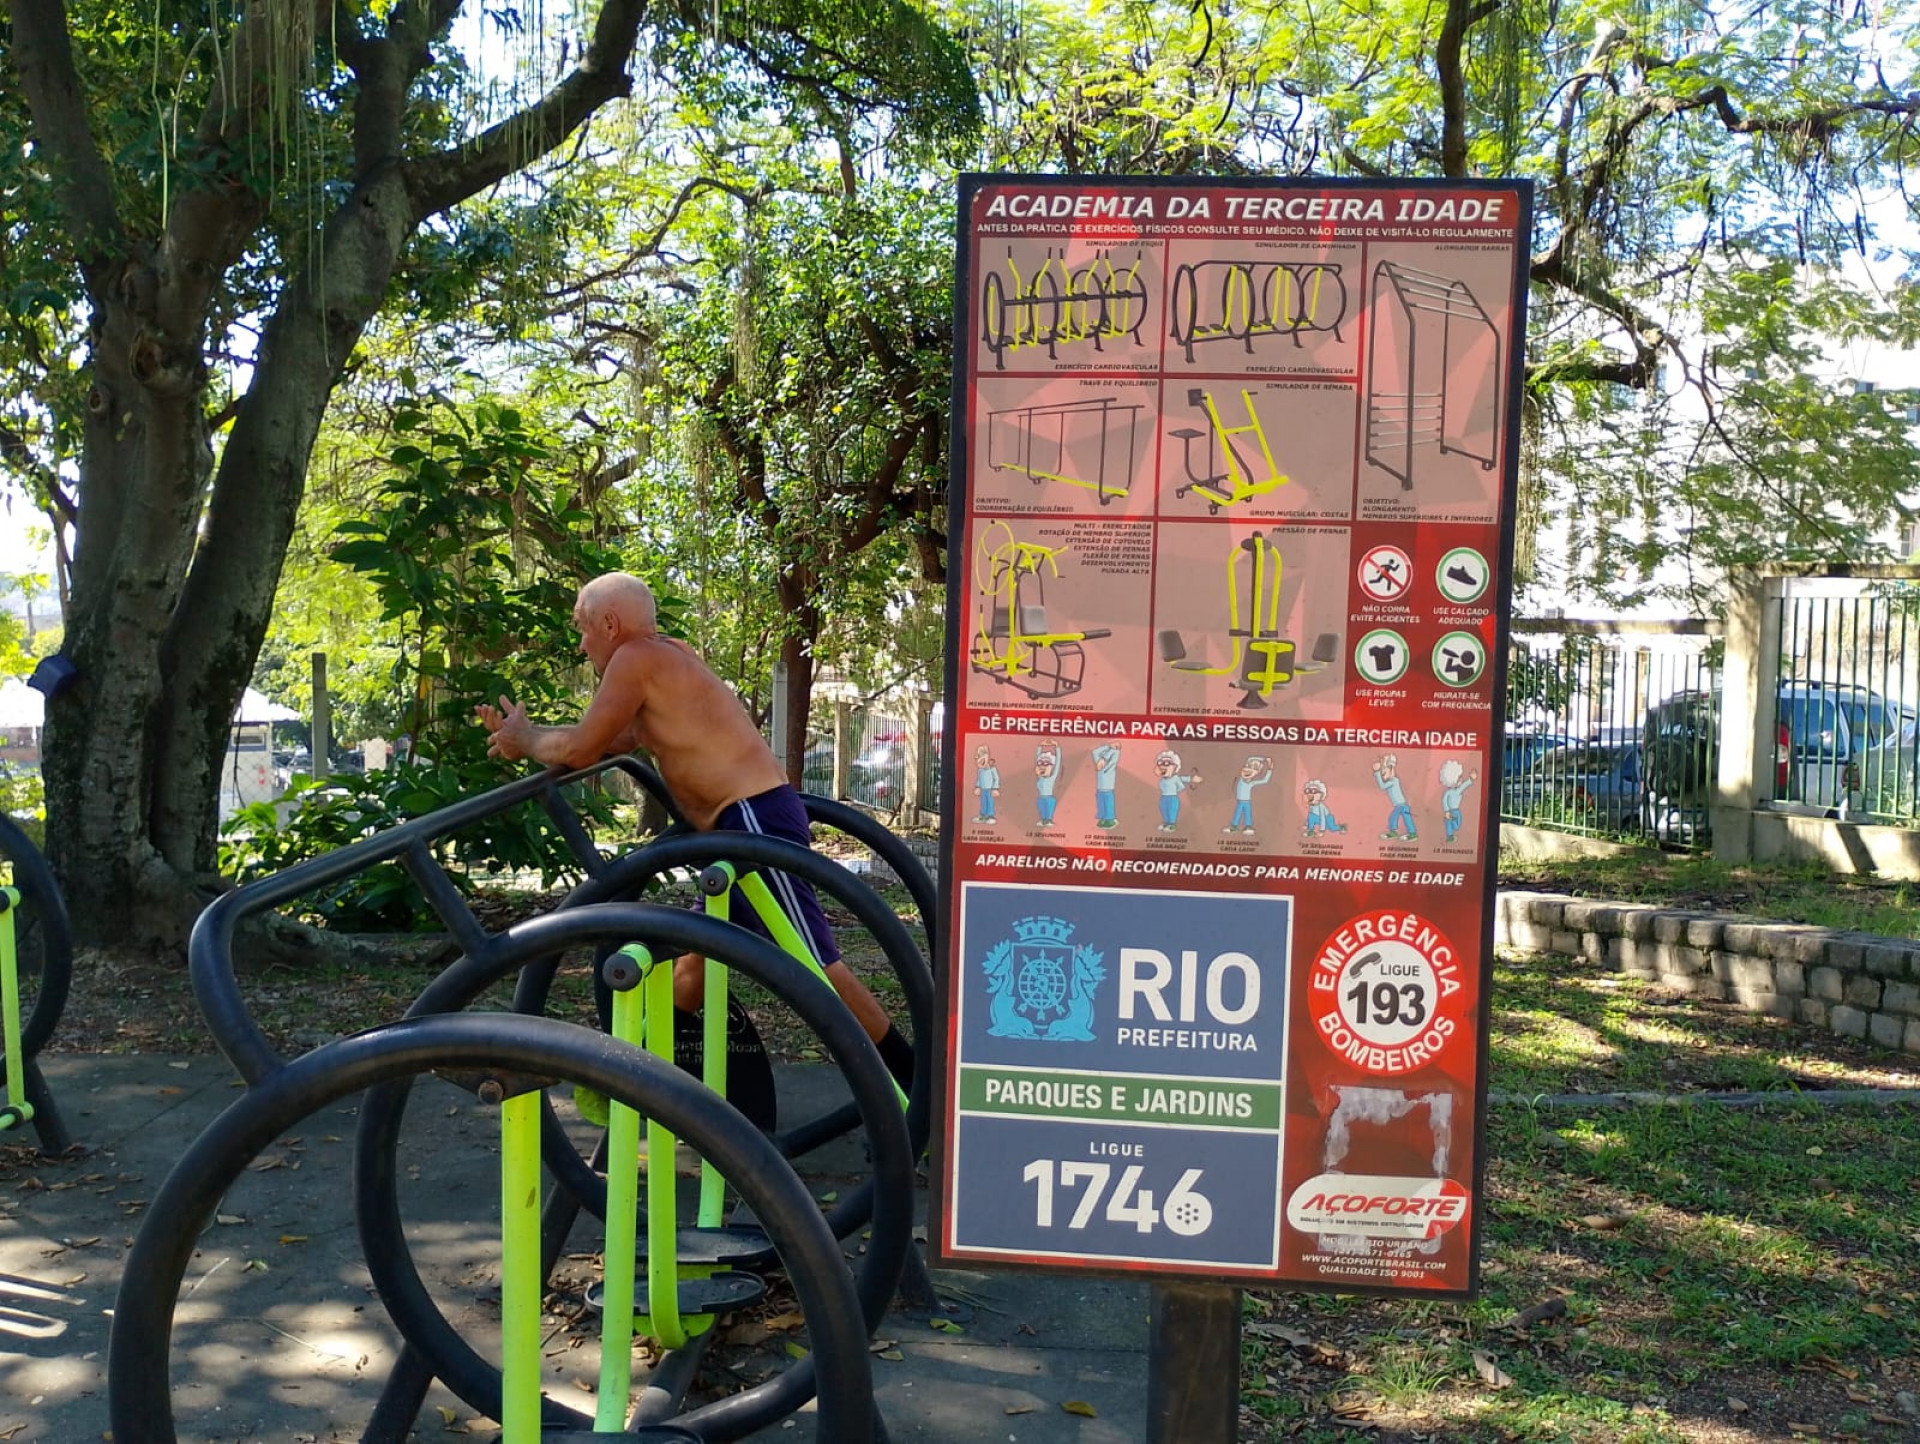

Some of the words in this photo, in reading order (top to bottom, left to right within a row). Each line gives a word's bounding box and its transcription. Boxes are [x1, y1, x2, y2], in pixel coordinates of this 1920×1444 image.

[985, 195, 1154, 218] ACADEMIA
[1166, 197, 1211, 219] DA
[1225, 197, 1384, 221] TERCEIRA
[1395, 199, 1503, 222] IDADE
[977, 223, 1009, 233] ANTES
[1011, 224, 1024, 233] DA
[1026, 222, 1067, 233] PRÁTICA
[1070, 225, 1082, 234] DE
[1085, 223, 1143, 234] EXERCÍCIOS
[1146, 223, 1184, 235] FÍSICOS
[1187, 225, 1240, 235] CONSULTE
[1242, 226, 1263, 235] SEU
[1266, 225, 1307, 236] MÉDICO.
[1309, 226, 1331, 236] NÃO
[1334, 227, 1363, 236] DEIXE
[1366, 227, 1379, 237] DE
[1382, 226, 1429, 237] VISITÁ-LO
[1432, 228, 1514, 238] REGULARMENTE
[1272, 526, 1305, 534] PRESSÃO
[1362, 604, 1380, 612] NÃO
[1433, 607, 1449, 615] USE
[1450, 608, 1489, 617] CALÇADO
[1350, 614, 1373, 622] EVITE
[1374, 615, 1420, 623] ACIDENTES
[1438, 617, 1482, 625] ADEQUADO
[1373, 690, 1406, 698] ROUPAS
[1434, 692, 1480, 700] HIDRATE-SE
[1368, 699, 1395, 707] LEVES
[1441, 701, 1491, 710] FREQUENCIA
[979, 713, 1000, 730] DÊ
[1006, 715, 1126, 735] PREFERÊNCIA
[1131, 721, 1179, 737] PARA
[1183, 723, 1207, 738] AS
[1212, 724, 1298, 741] PESSOAS
[1304, 728, 1329, 742] DA
[1334, 728, 1420, 745] TERCEIRA
[1425, 731, 1477, 746] IDADE
[975, 854, 1068, 870] APARELHOS
[1071, 855, 1107, 872] NÃO
[1111, 860, 1251, 878] RECOMENDADOS
[1254, 866, 1299, 879] PARA
[1304, 868, 1384, 883] MENORES
[1387, 871, 1410, 884] DE
[1412, 872, 1465, 886] IDADE
[1313, 914, 1460, 998] EMERGÊNCIA
[1380, 964, 1421, 977] LIGUE
[1118, 947, 1261, 1025] RIO
[1347, 981, 1426, 1026] 193
[1117, 1028, 1258, 1052] PREFEITURA
[1318, 1011, 1455, 1072] BOMBEIROS
[985, 1078, 1102, 1109] PARQUES
[1111, 1086, 1127, 1111] E
[1134, 1089, 1252, 1118] JARDINS
[1090, 1141, 1144, 1157] LIGUE
[1023, 1159, 1213, 1236] 1746
[1301, 1193, 1460, 1217] AÇOFORTE
[1302, 1254, 1446, 1270] WWW.ACOFORTEBRASIL.COM
[1319, 1265, 1377, 1276] QUALIDADE
[1379, 1268, 1398, 1277] ISO
[1400, 1269, 1424, 1278] 9001
